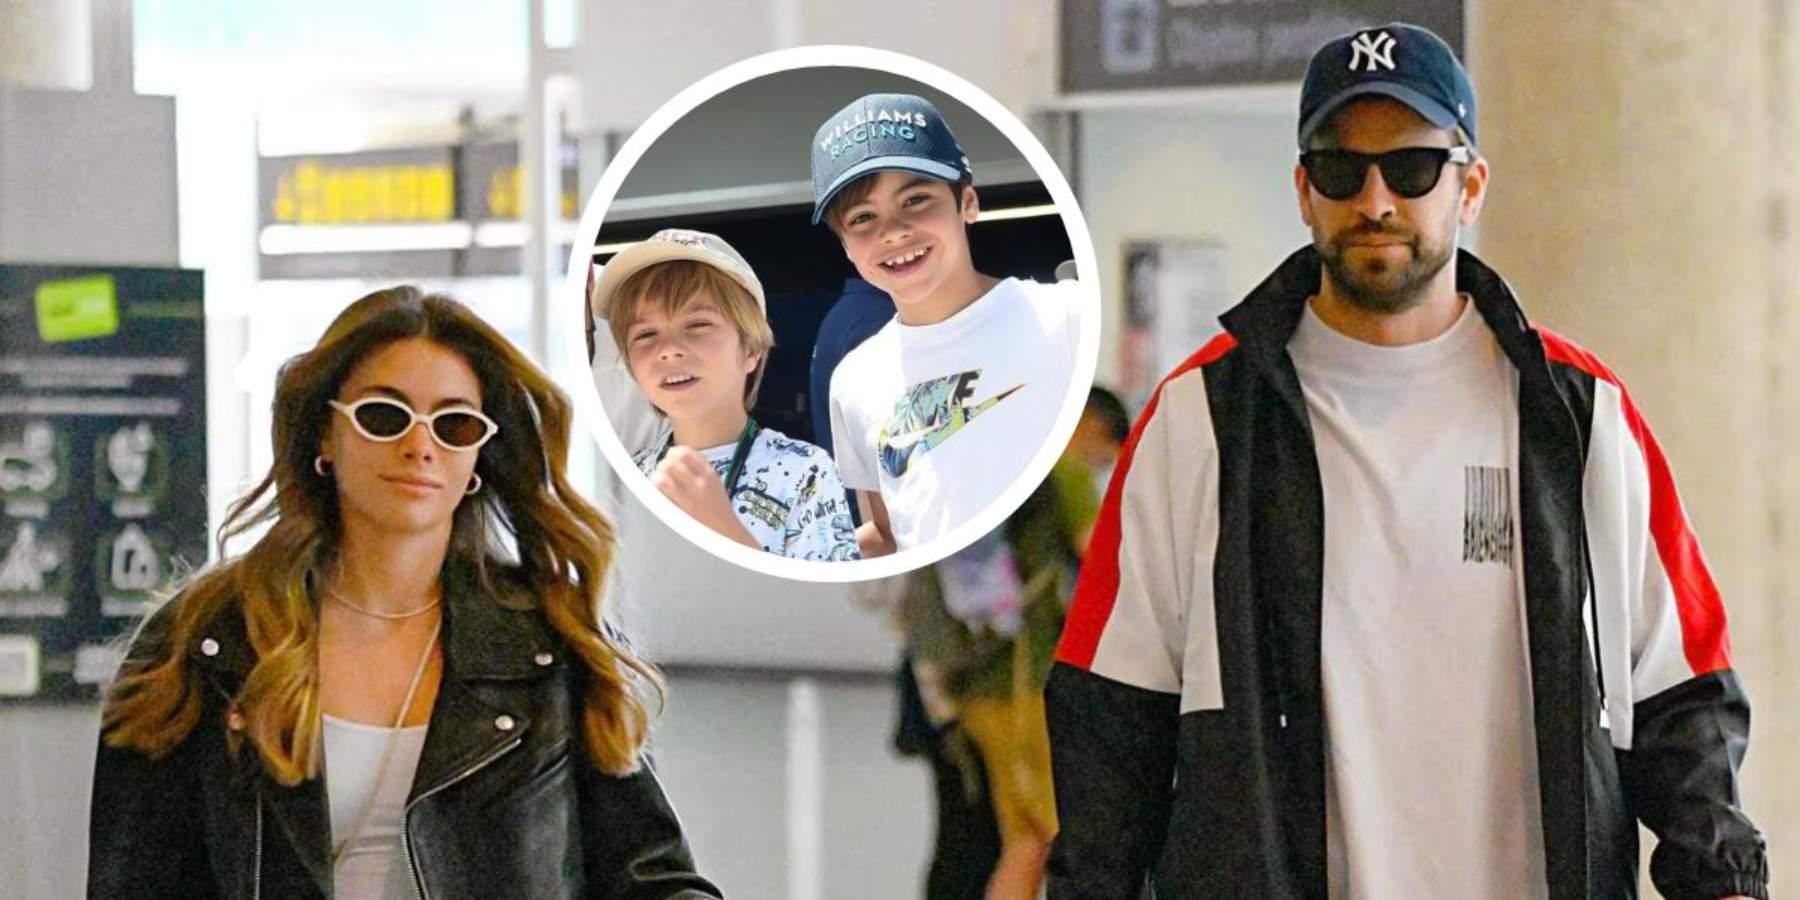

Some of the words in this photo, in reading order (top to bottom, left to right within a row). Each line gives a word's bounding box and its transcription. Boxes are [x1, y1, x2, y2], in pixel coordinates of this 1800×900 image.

[1348, 31, 1397, 71] NY
[820, 109, 927, 151] WILLIAMS
[831, 125, 915, 160] RACING
